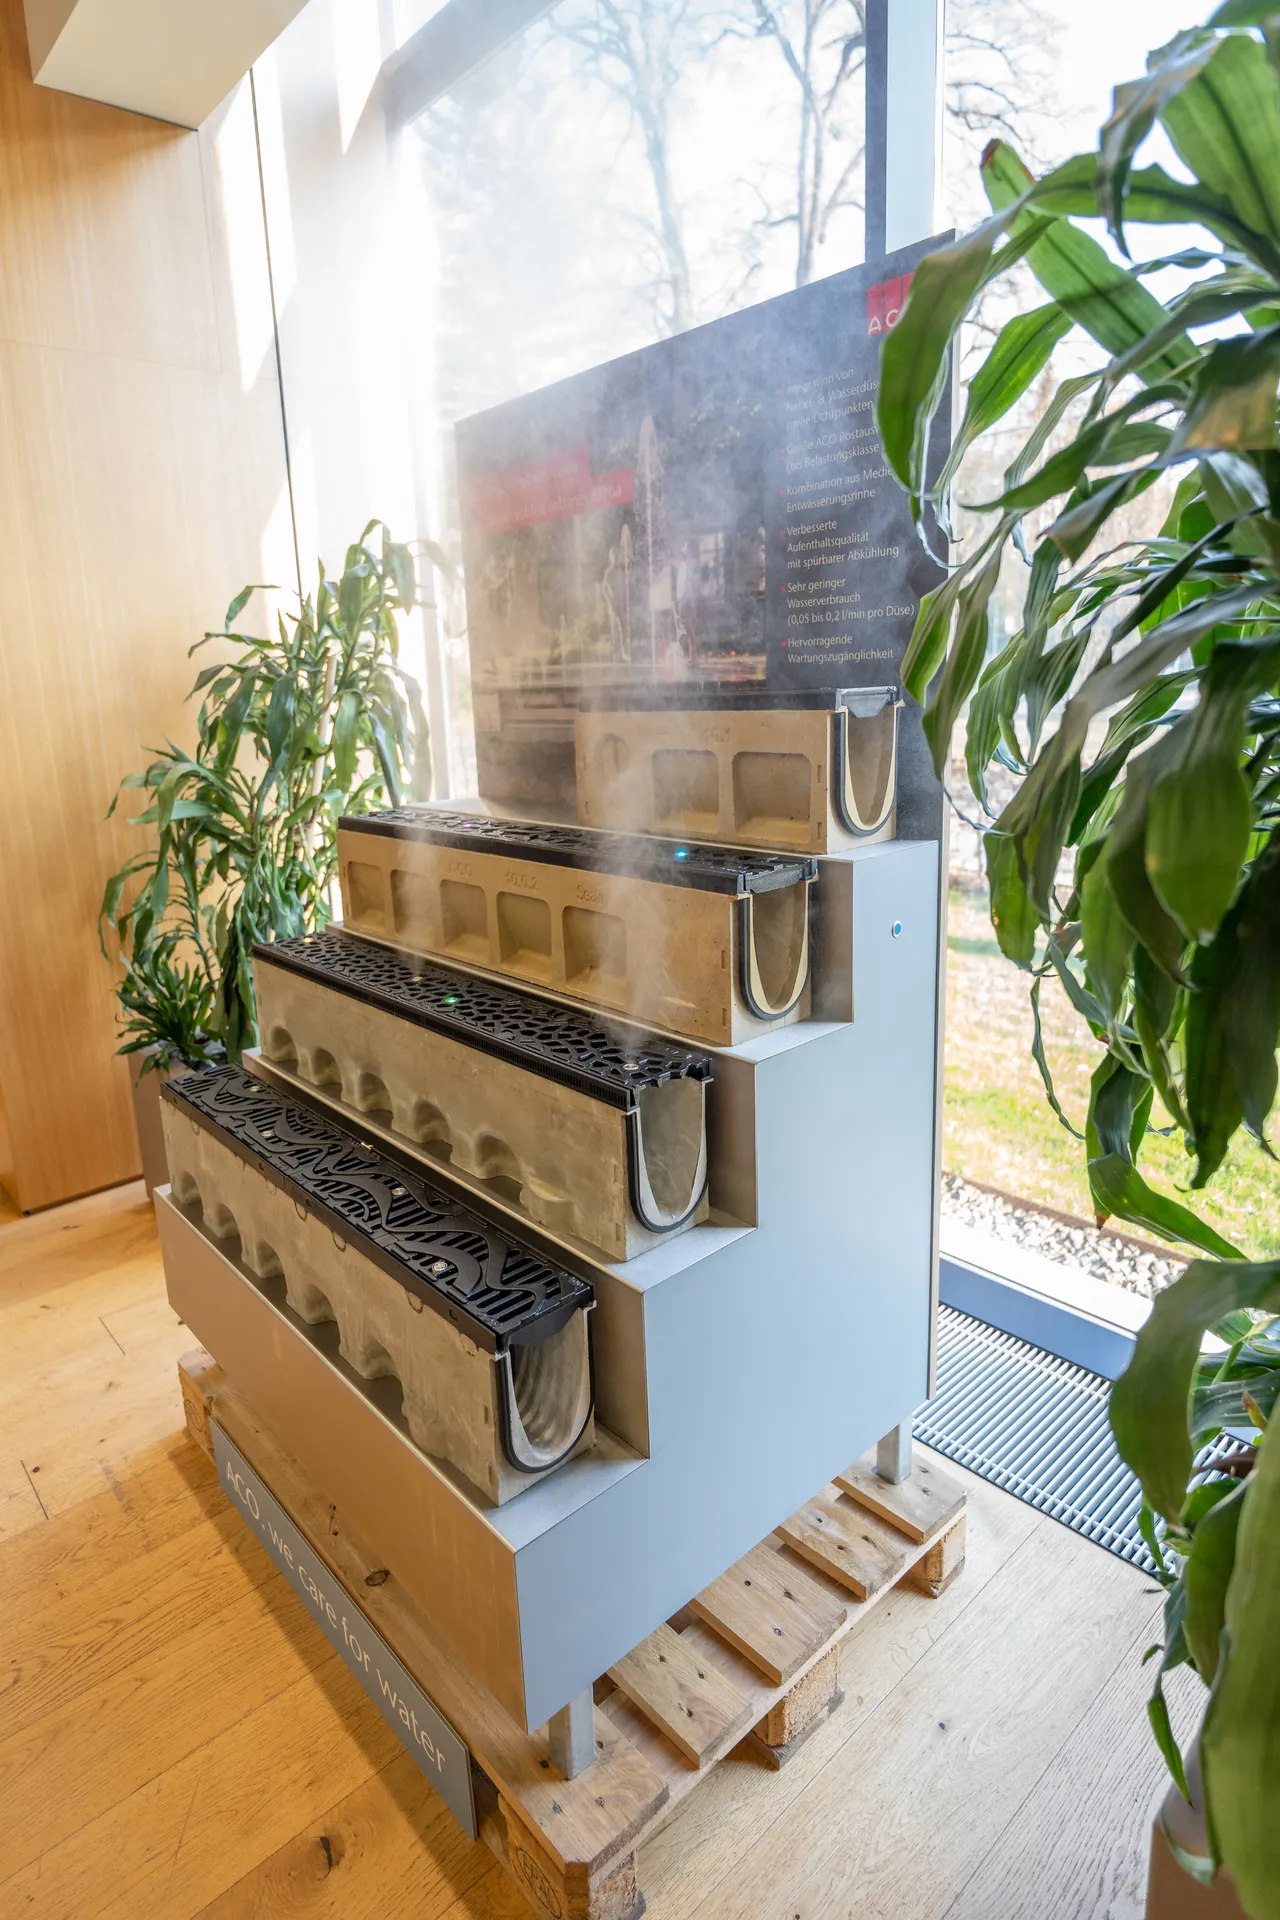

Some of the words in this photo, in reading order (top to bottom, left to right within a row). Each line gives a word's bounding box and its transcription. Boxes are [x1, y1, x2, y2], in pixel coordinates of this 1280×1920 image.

[868, 308, 899, 335] AC
[837, 368, 854, 381] von
[816, 433, 837, 449] ACO
[805, 443, 880, 467] Belastungsklasse
[787, 477, 842, 497] Kombination
[845, 474, 861, 485] aus
[863, 466, 893, 481] Medie
[787, 488, 876, 513] Entwässerungsrinne
[787, 520, 838, 536] Verbesserte
[787, 532, 870, 553] Aufenthaltsqualität
[787, 558, 801, 569] mit
[804, 553, 845, 569] spürbarer
[848, 546, 899, 561] Abkühlung
[787, 582, 806, 593] Sehr
[808, 578, 846, 593] geringer
[787, 592, 861, 609] Wasserverbrauch
[787, 614, 809, 627] (0,05
[812, 613, 824, 622] bis
[825, 611, 840, 623] 0,2
[842, 609, 865, 621] l/min
[867, 608, 883, 620] pro
[886, 604, 915, 617] Düse)
[788, 634, 853, 649] Hervorragende
[788, 648, 894, 664] Wartungszugänglichkeit
[268, 1521, 295, 1569] we
[298, 1565, 337, 1629] care
[342, 1616, 371, 1673] for
[376, 1668, 445, 1773] water
